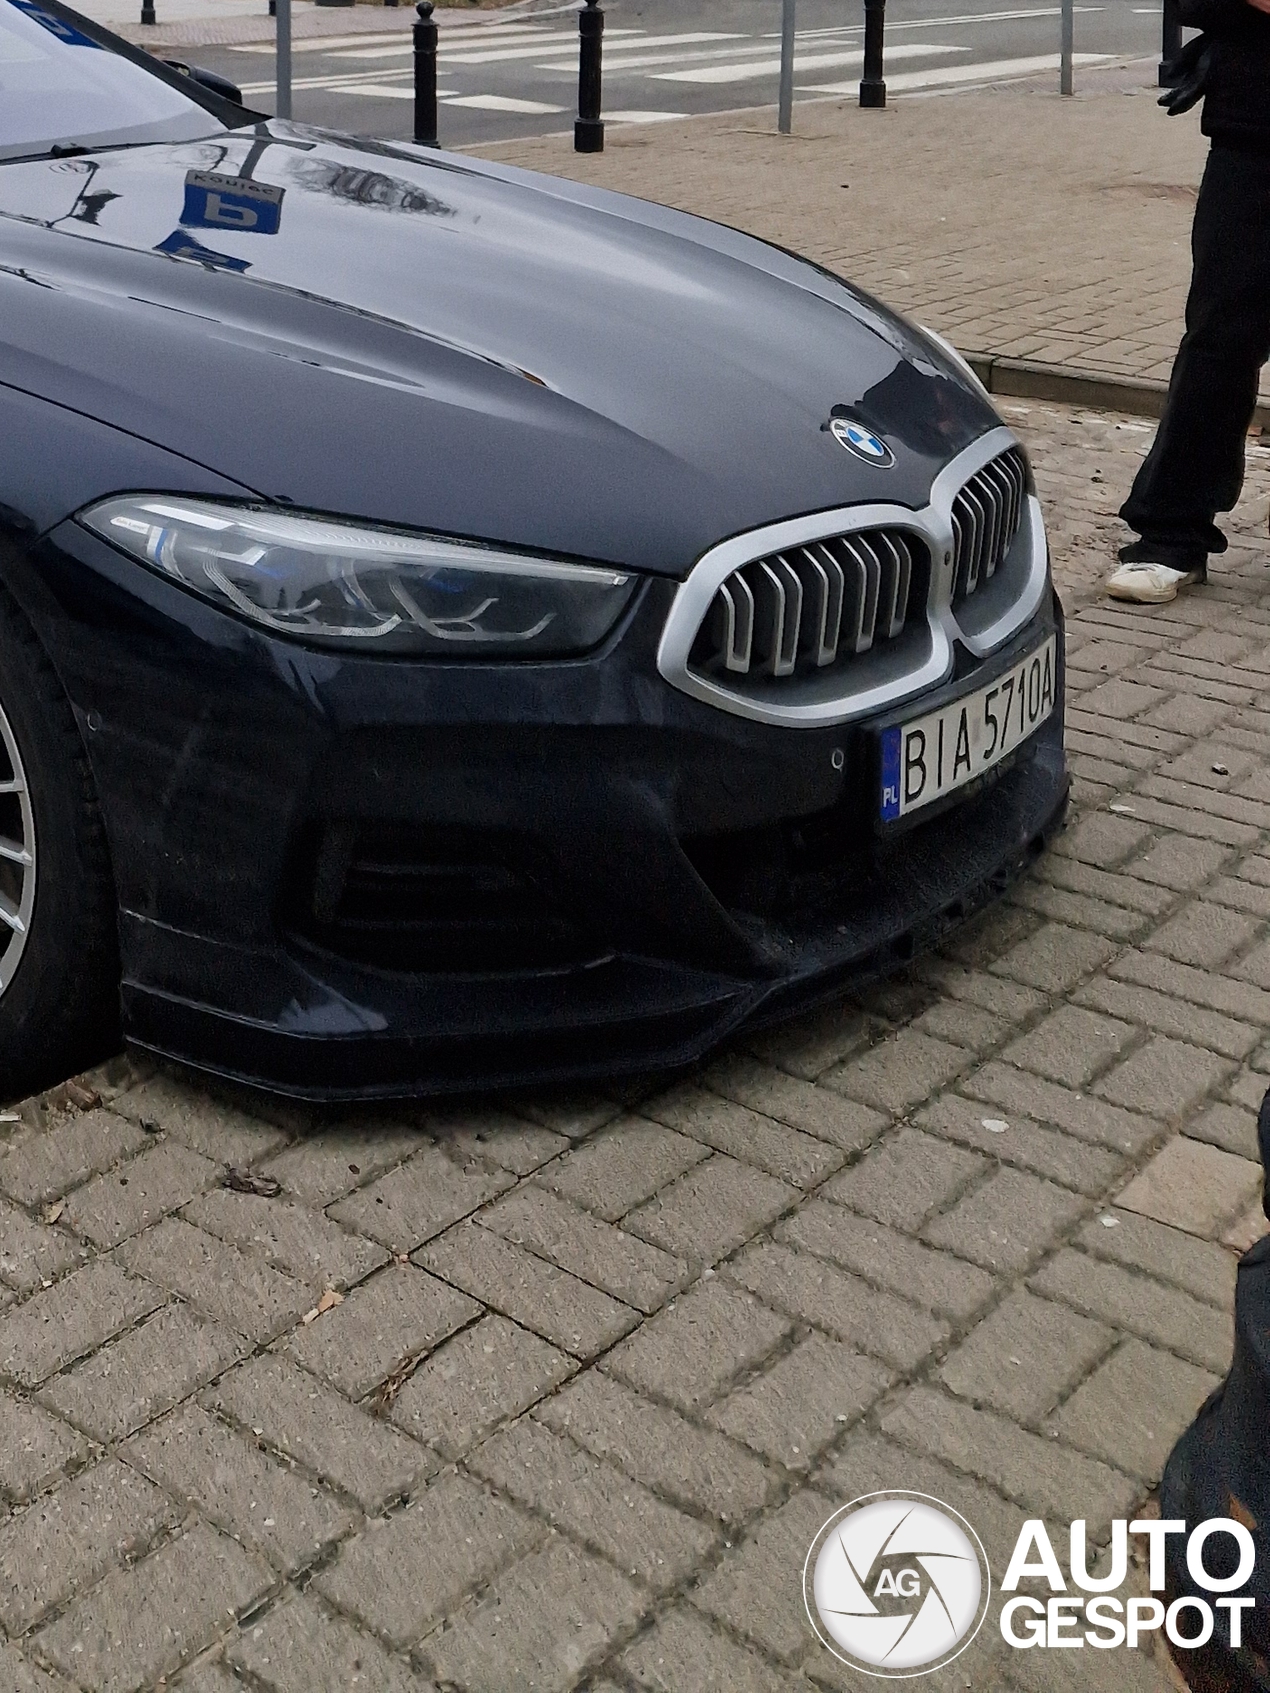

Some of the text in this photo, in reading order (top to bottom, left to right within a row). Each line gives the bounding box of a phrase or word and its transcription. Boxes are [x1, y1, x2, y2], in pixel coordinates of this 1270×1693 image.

[904, 647, 1054, 805] BIA 5710A
[882, 786, 899, 808] PL
